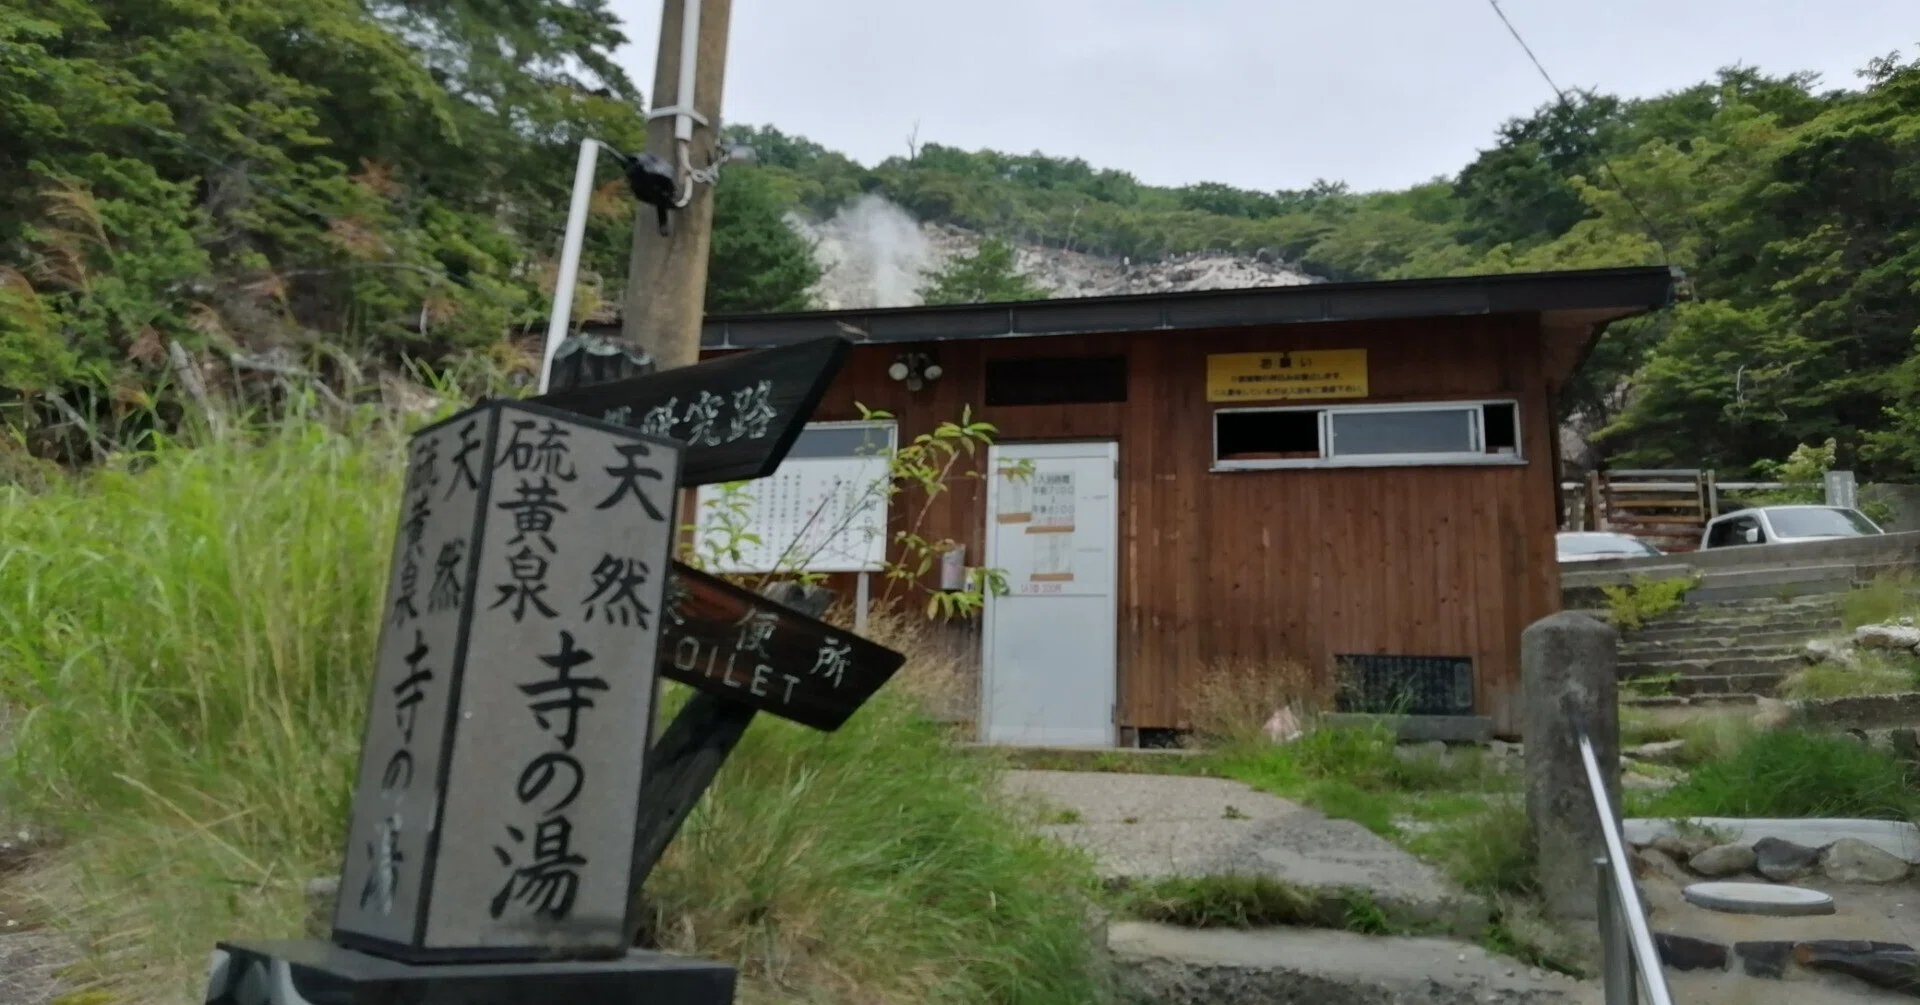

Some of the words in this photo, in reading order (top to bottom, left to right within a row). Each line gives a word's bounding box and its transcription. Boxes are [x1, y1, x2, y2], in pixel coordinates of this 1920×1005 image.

[427, 419, 482, 613] 天然
[488, 417, 578, 624] 硫黄泉
[582, 442, 666, 632] 天然
[664, 628, 802, 705] OILET
[489, 630, 610, 922] 寺の湯
